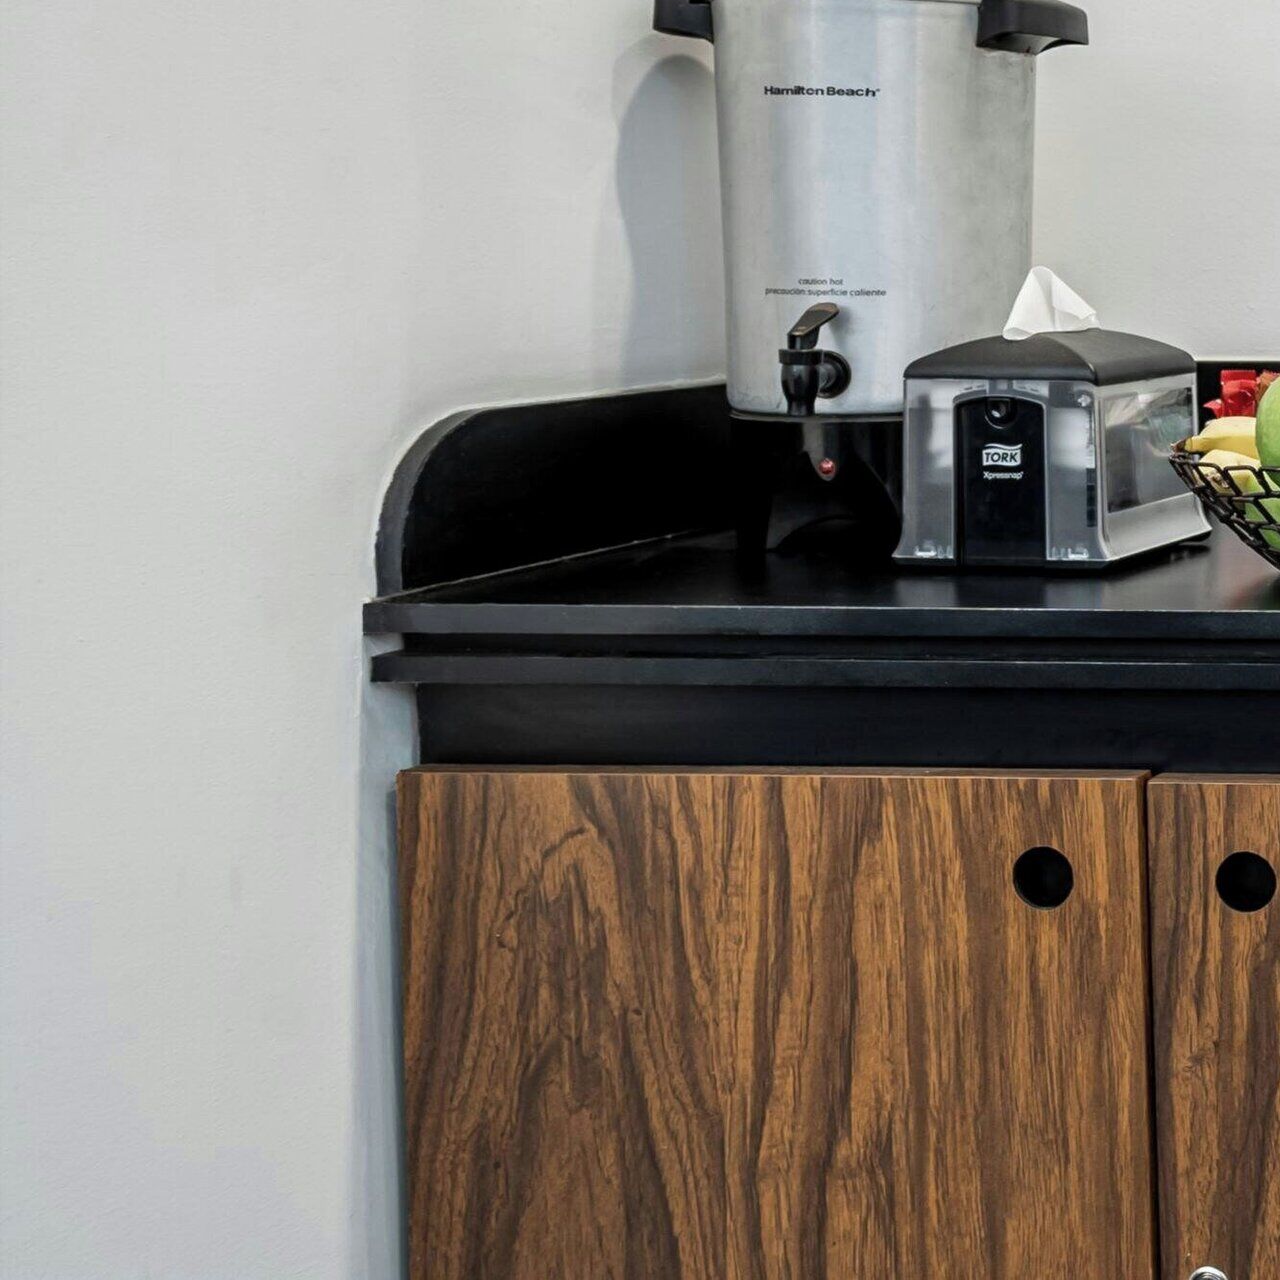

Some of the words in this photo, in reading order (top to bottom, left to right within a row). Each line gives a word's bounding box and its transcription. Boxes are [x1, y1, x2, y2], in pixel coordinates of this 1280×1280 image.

[763, 85, 825, 96] Hamilton
[826, 86, 877, 97] Beach
[984, 452, 1017, 463] TORK
